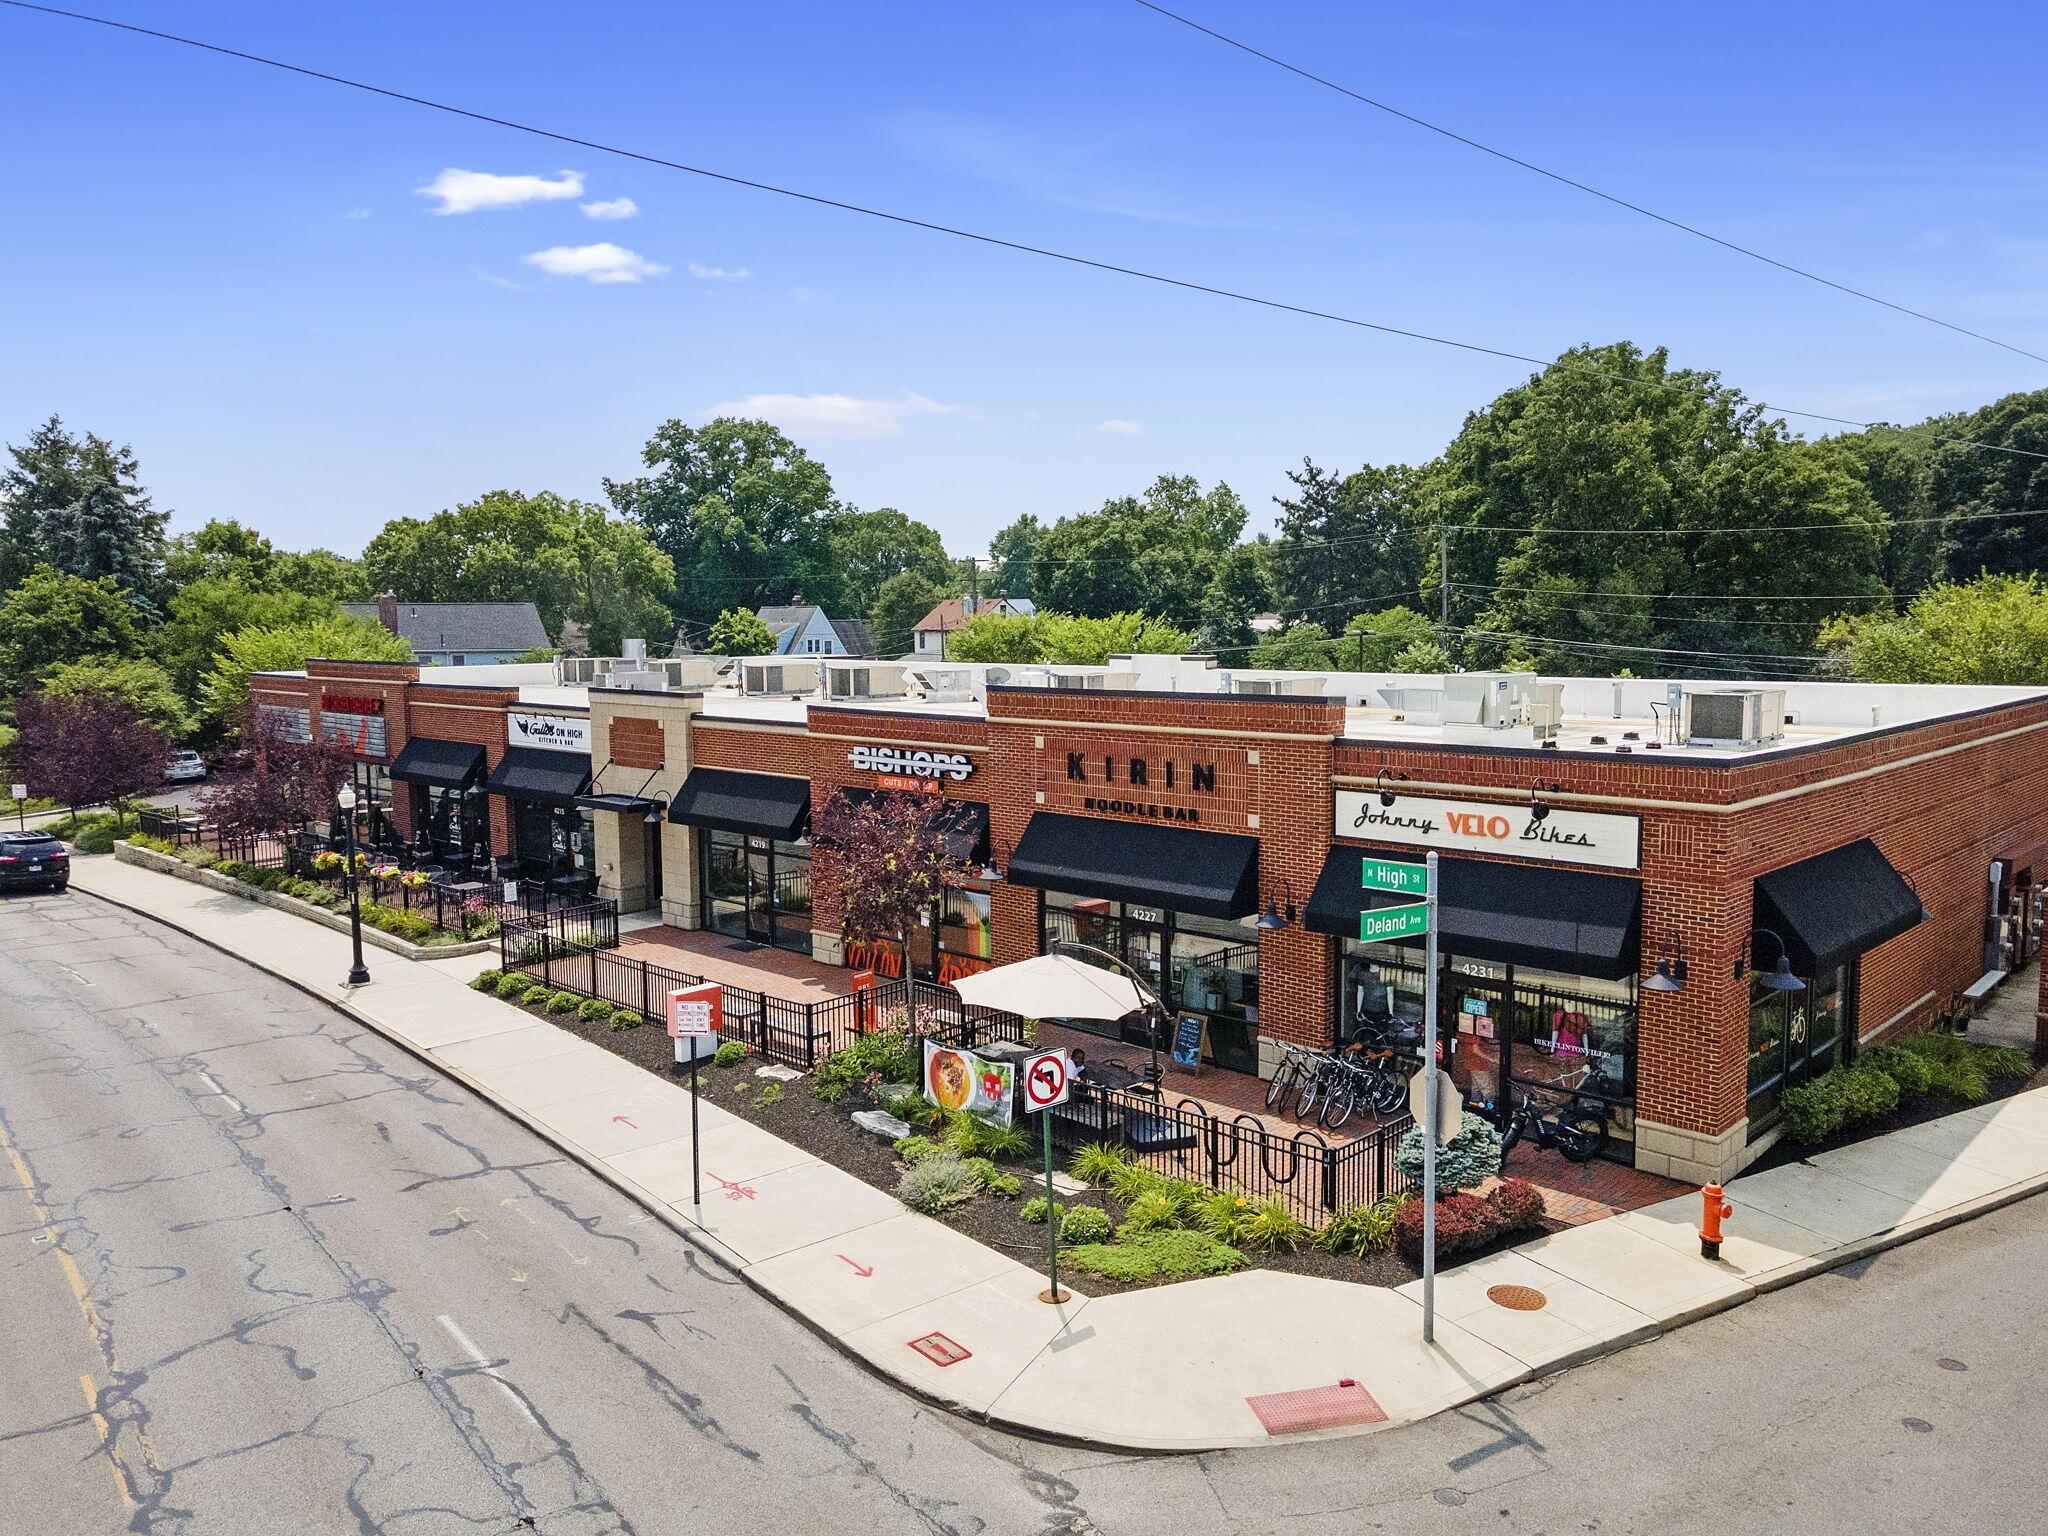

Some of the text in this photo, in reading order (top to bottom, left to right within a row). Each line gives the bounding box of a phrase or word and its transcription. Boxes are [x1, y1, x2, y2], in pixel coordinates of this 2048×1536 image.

[556, 728, 566, 738] ON
[567, 729, 583, 739] HIGH
[853, 746, 969, 780] BISHOPS
[1067, 752, 1215, 793] KIRIN
[883, 777, 902, 787] CUTS
[1084, 797, 1198, 822] NOODLE BAR
[1354, 803, 1596, 848] Johnny VELO Bikes
[1367, 866, 1420, 888] N High St
[1132, 909, 1157, 922] 4227
[1366, 913, 1422, 935] Deland Ave
[1461, 963, 1494, 979] 4231
